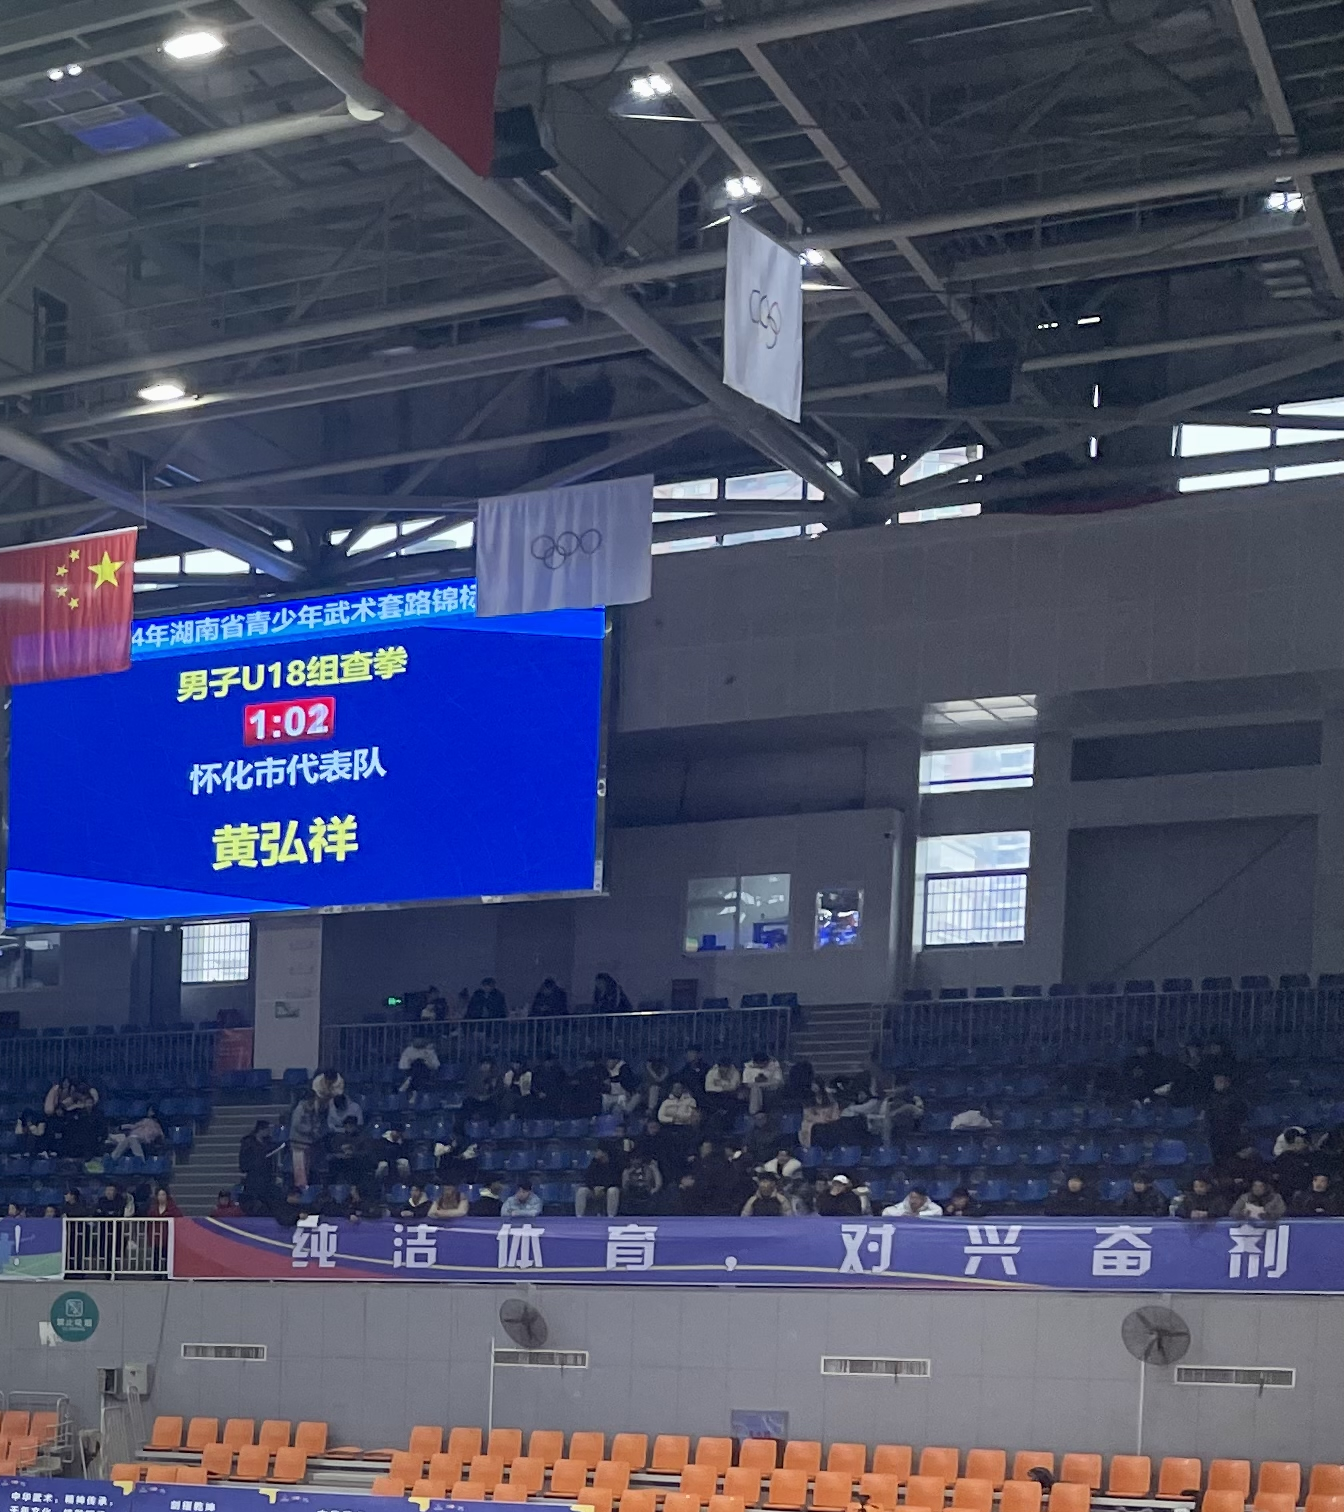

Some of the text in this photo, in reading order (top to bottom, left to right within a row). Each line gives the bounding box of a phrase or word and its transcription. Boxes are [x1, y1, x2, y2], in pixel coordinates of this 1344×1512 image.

[177, 646, 409, 703] 男子U18组查拳
[250, 705, 329, 740] 1:02
[189, 747, 387, 796] 怀化市代表队
[212, 815, 359, 872] 黄弘祥
